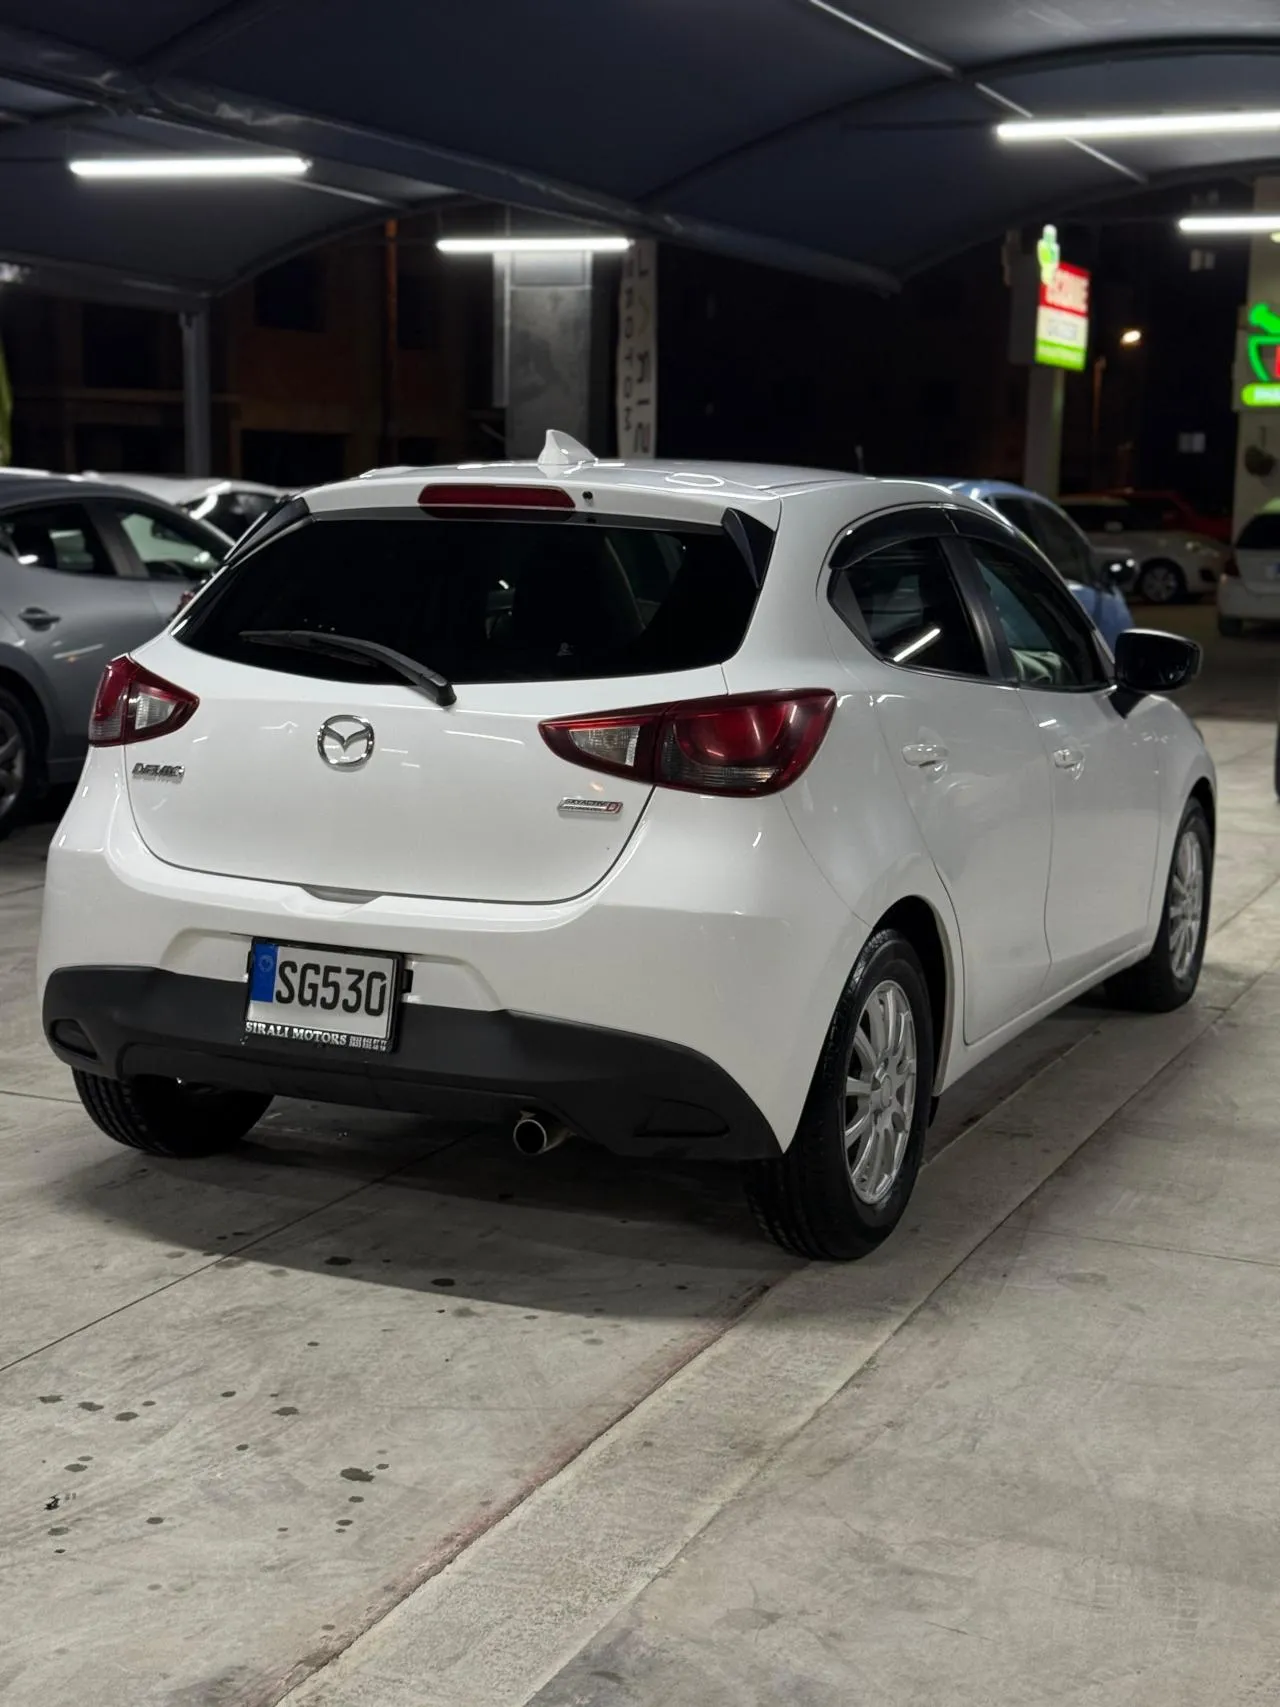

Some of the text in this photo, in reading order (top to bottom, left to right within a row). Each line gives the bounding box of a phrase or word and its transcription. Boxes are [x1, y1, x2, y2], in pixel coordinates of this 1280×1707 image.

[275, 960, 387, 1017] SG530
[245, 1021, 290, 1038] SIRALI
[292, 1027, 347, 1045] MOTORS
